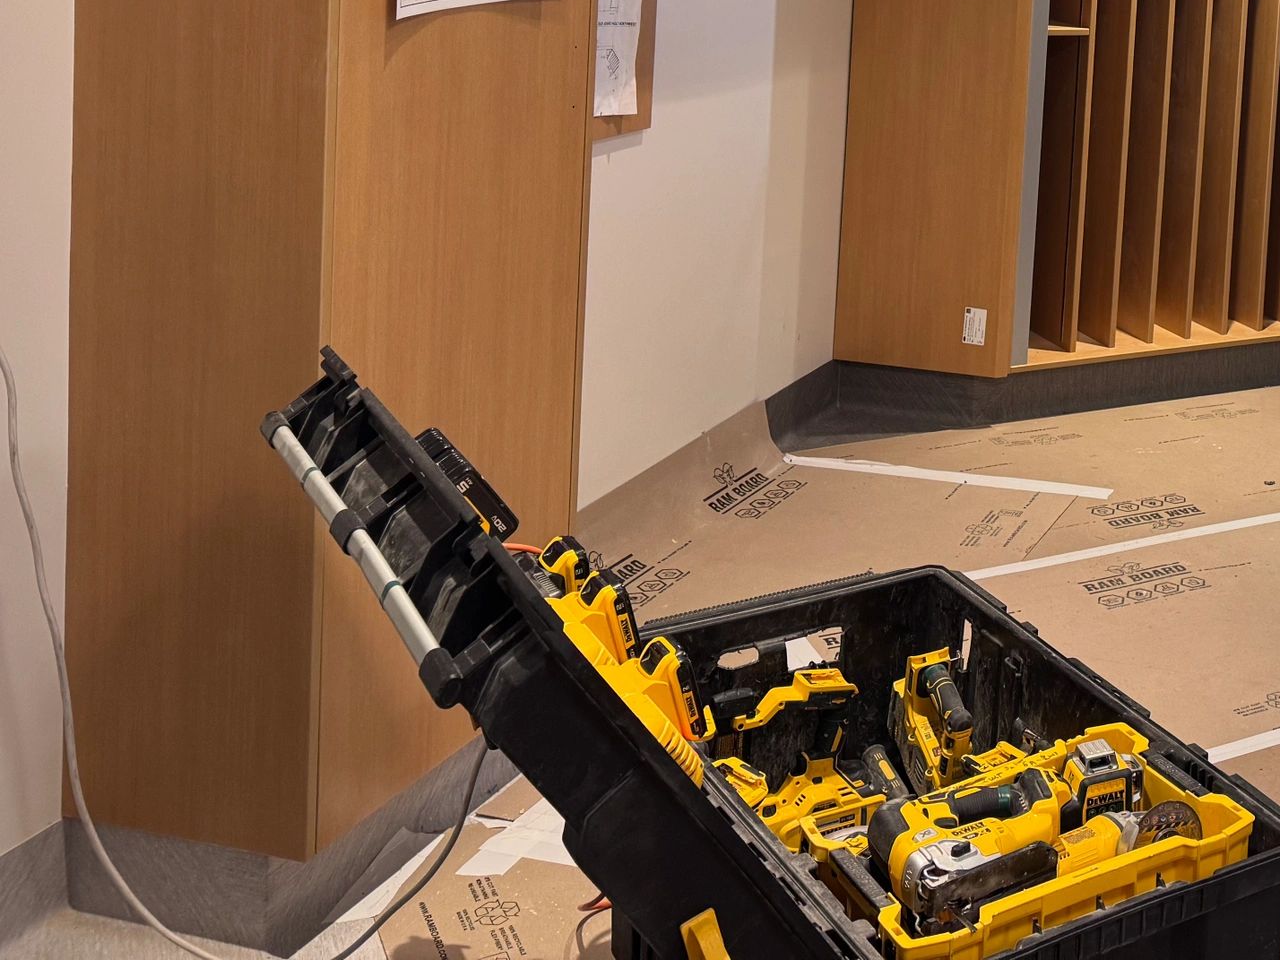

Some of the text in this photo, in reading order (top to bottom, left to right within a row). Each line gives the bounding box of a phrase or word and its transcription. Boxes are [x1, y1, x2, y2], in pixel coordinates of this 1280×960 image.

[708, 472, 770, 513] RAM BOARD
[1107, 505, 1202, 528] RAM BOARD
[616, 559, 648, 580] ARD
[1082, 564, 1188, 592] RAM BOARD
[619, 617, 634, 643] DEWALT
[684, 695, 698, 718] DEWALT
[1087, 789, 1125, 807] DEWALT
[951, 821, 986, 837] DEWALT
